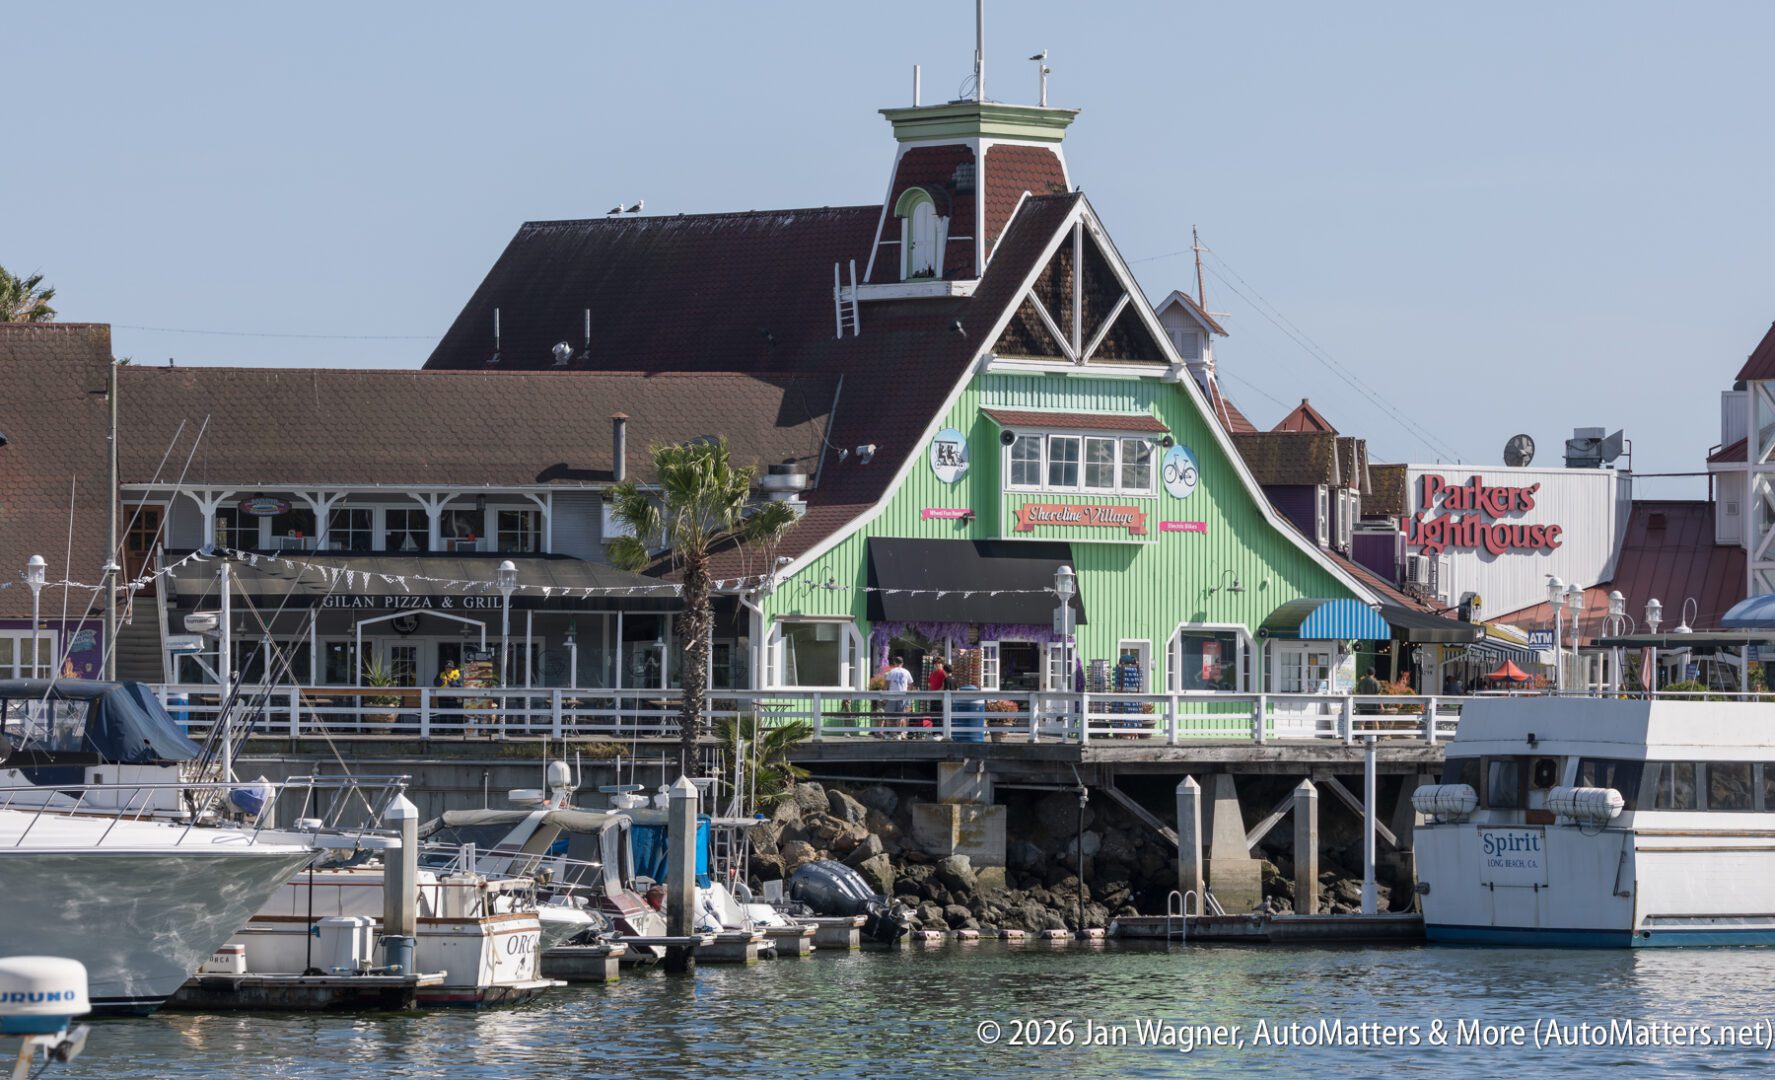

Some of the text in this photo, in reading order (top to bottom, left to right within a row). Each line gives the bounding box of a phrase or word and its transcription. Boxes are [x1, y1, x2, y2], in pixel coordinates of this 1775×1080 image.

[1028, 505, 1134, 525] Shoreline Village
[1400, 511, 1563, 556] Lighthouse
[323, 596, 375, 608] GILAN
[385, 596, 433, 608] PIZZA
[441, 596, 454, 608] &
[1530, 632, 1552, 643] ATM
[1483, 832, 1540, 856] Spirit
[1487, 859, 1504, 868] LONG
[506, 934, 537, 956] ORC
